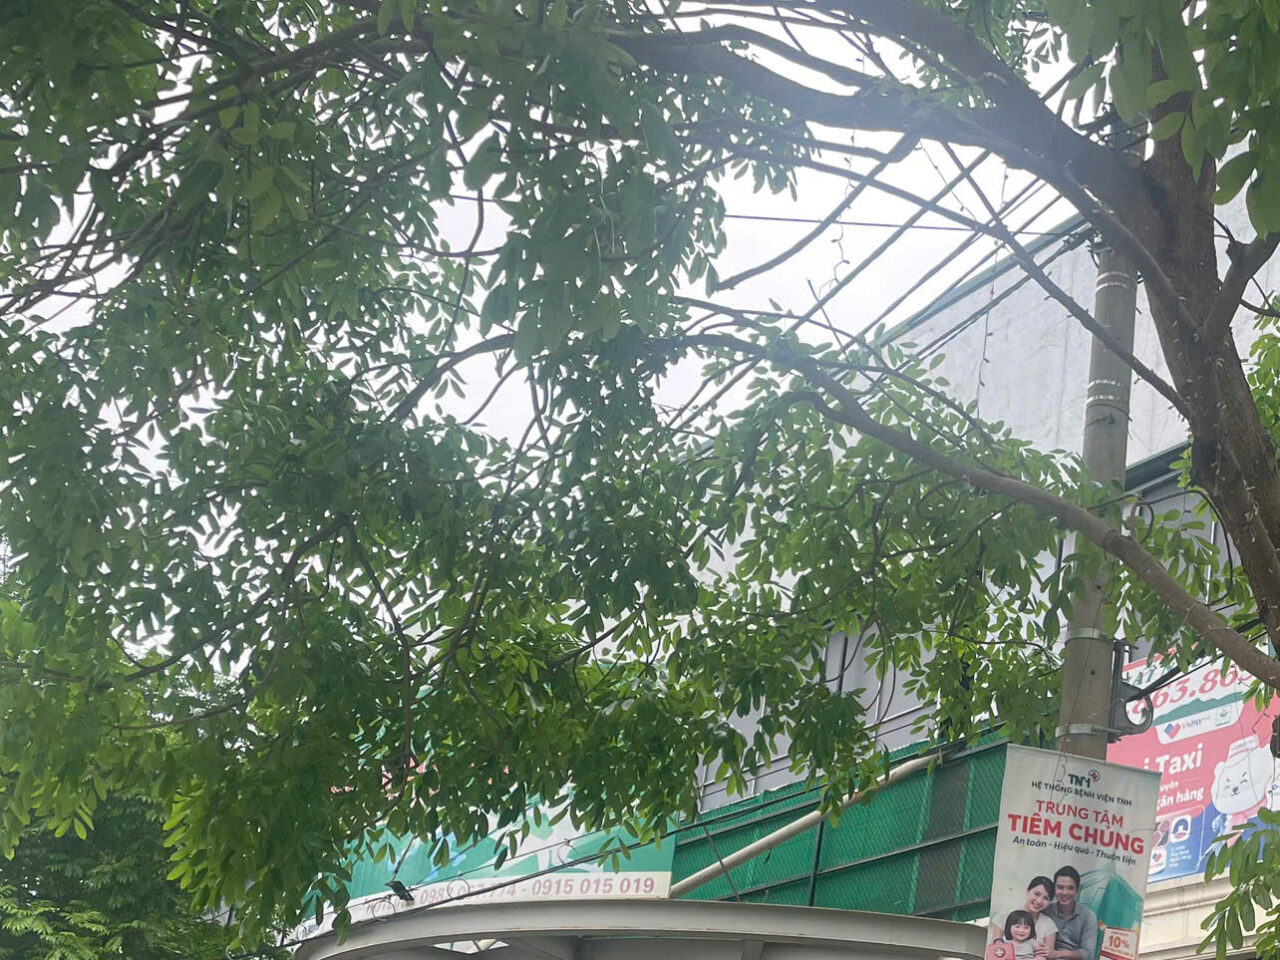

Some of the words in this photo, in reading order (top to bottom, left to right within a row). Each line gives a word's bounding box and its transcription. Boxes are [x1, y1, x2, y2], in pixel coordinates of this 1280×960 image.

[1155, 743, 1203, 775] Taxi
[1044, 779, 1073, 794] THỐNG
[1074, 788, 1095, 799] BỆNH
[1176, 787, 1204, 804] hàng
[1036, 800, 1088, 819] TRUNG
[1093, 810, 1123, 828] TÂM
[1008, 813, 1062, 838] TIÊM
[1068, 823, 1144, 854] CHỦNG
[1013, 836, 1025, 845] An
[1026, 838, 1047, 847] toàn
[1054, 841, 1073, 851] Hiệu
[532, 878, 574, 896] 0915
[580, 878, 613, 894] 015
[620, 877, 655, 894] 019
[1108, 935, 1130, 949] 10%
